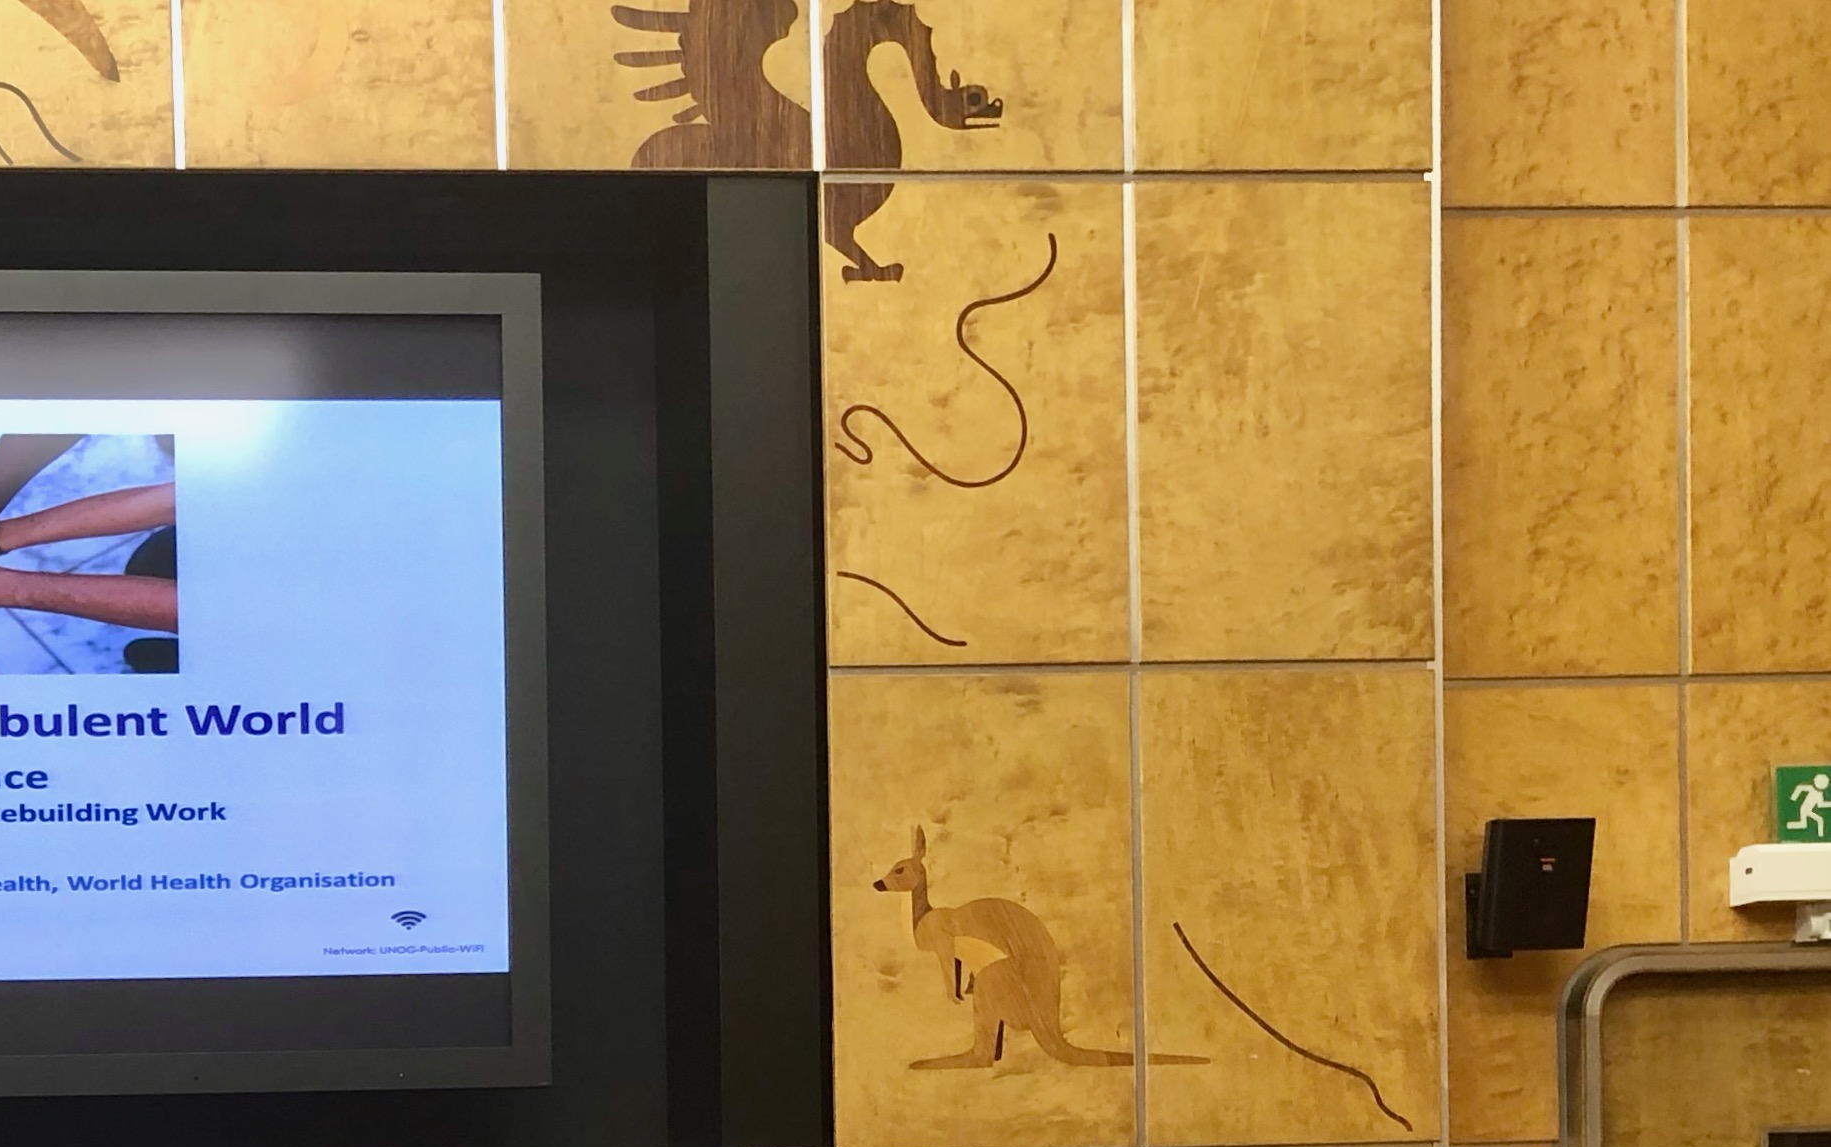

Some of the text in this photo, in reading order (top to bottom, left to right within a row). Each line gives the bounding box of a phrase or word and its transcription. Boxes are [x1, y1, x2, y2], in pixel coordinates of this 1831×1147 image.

[185, 702, 344, 735] World
[146, 802, 226, 821] Work
[67, 874, 142, 891] World
[151, 873, 230, 890] Health
[240, 872, 395, 892] Organisation
